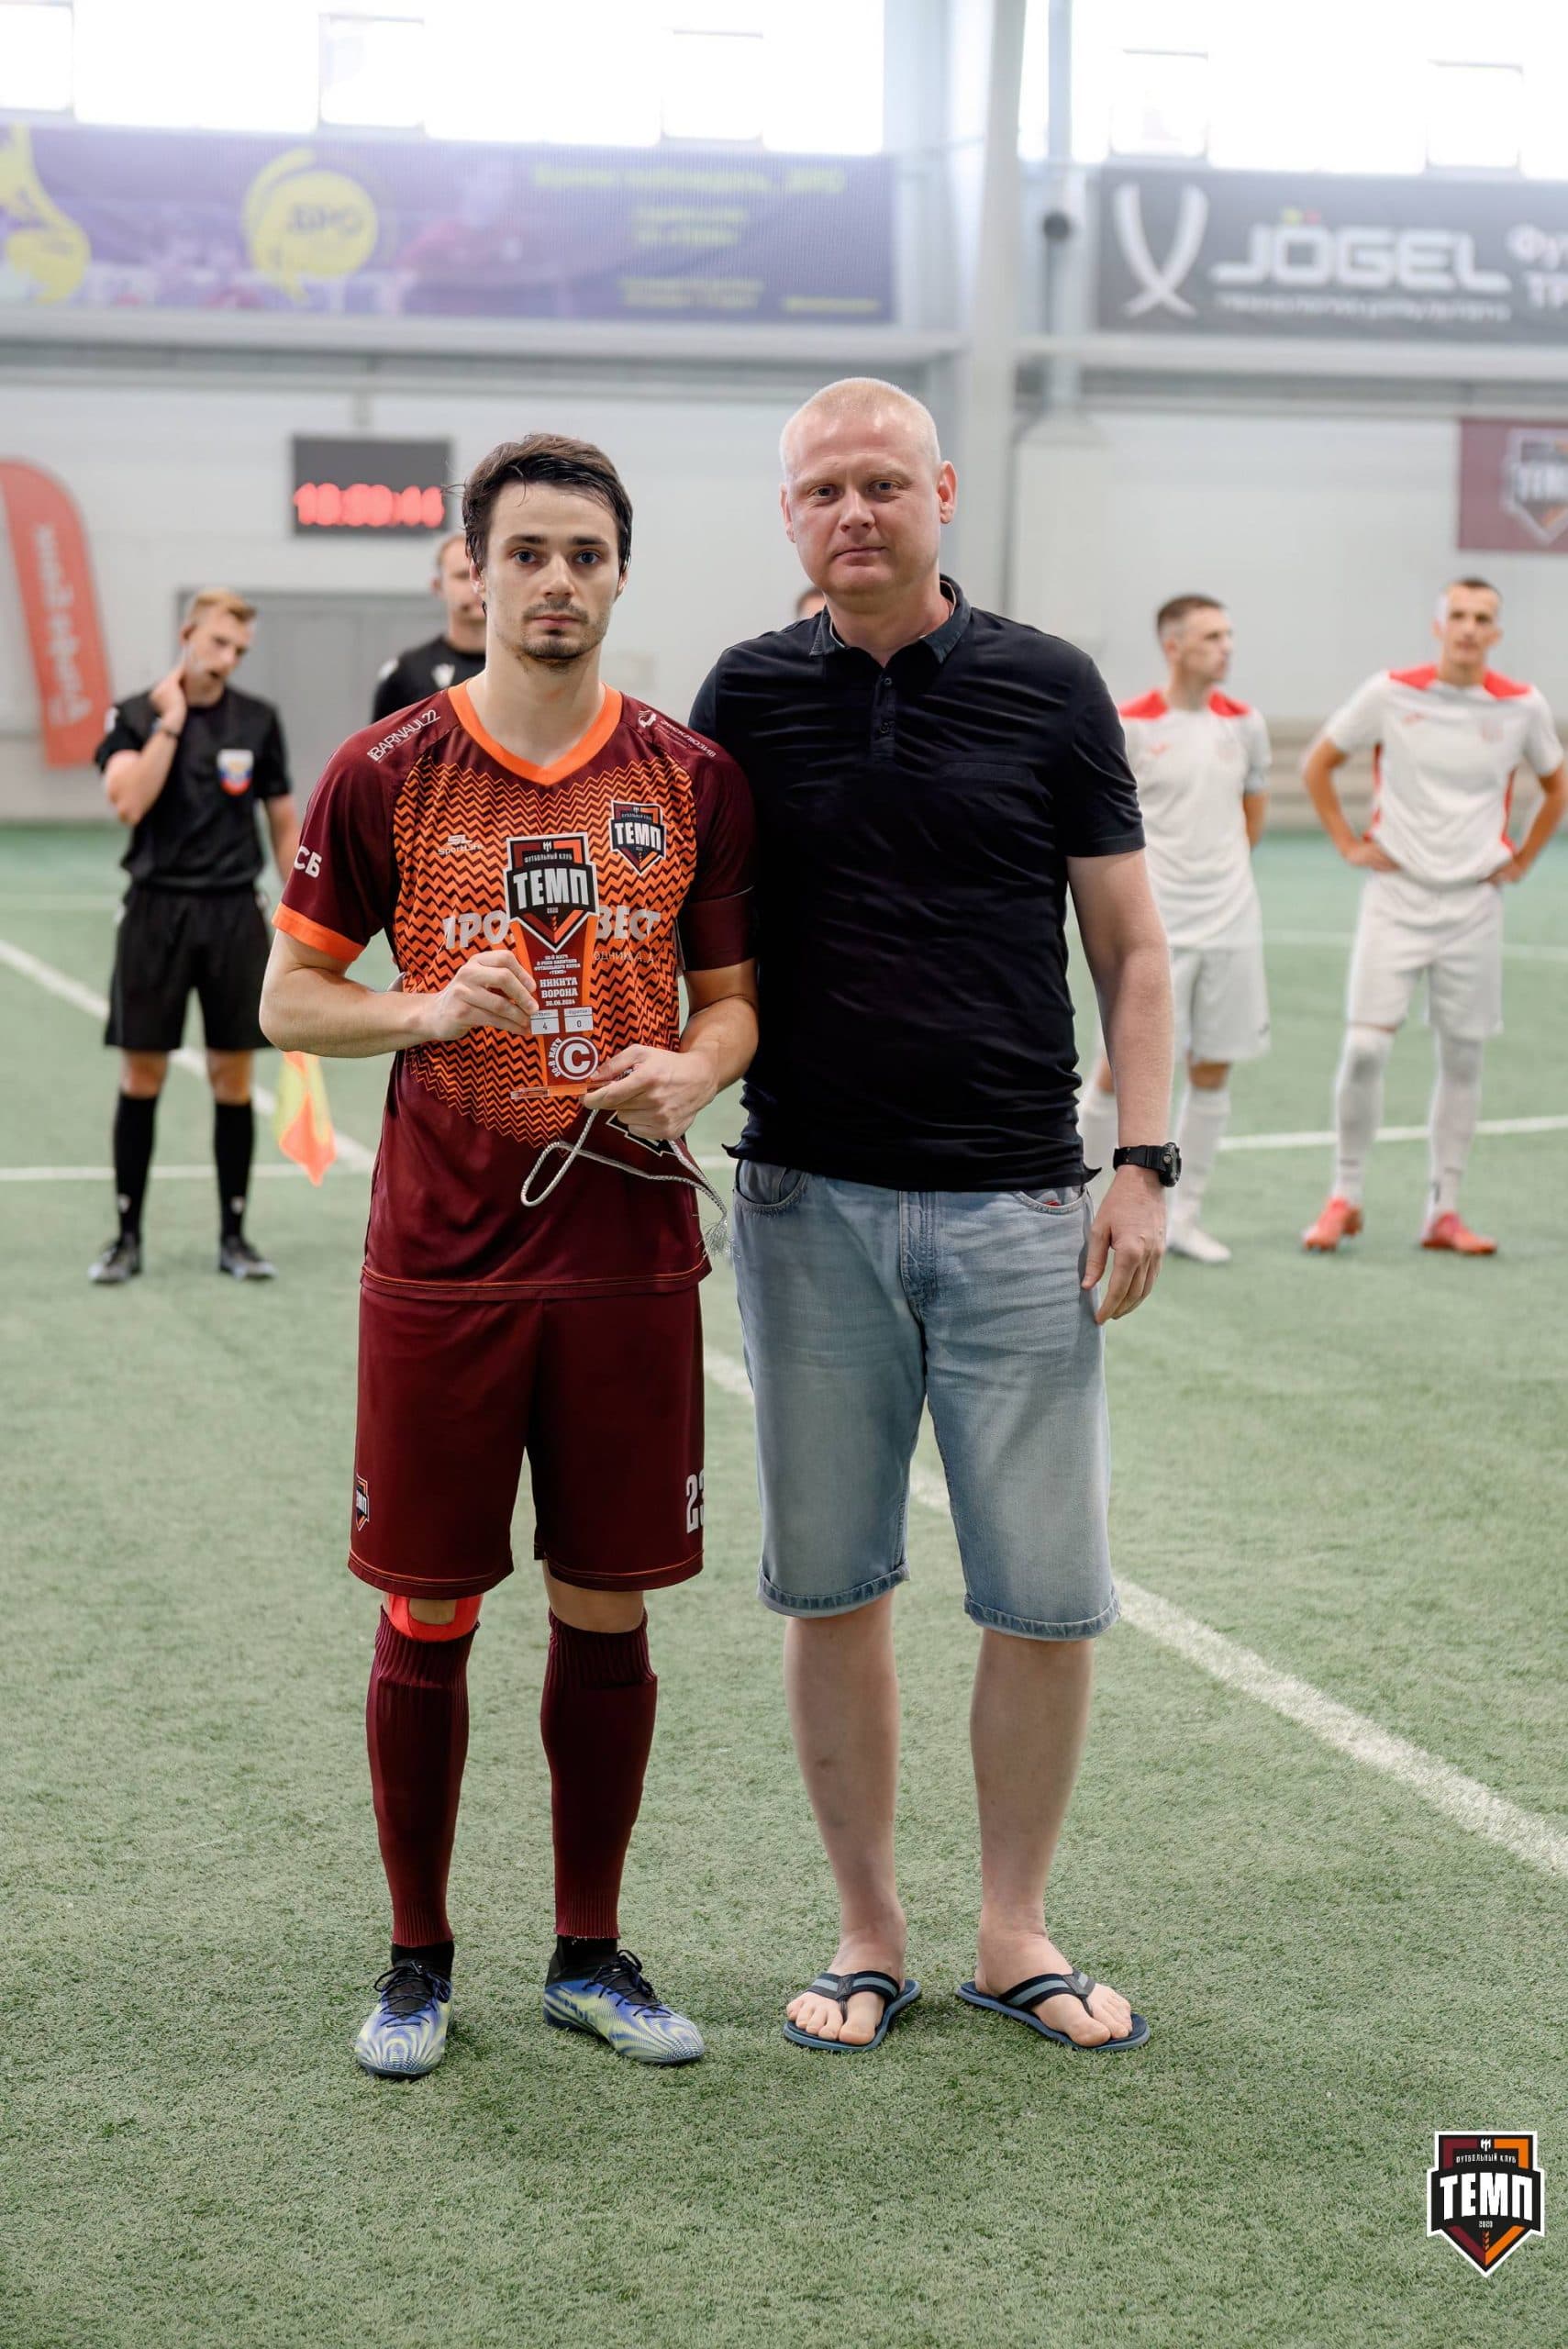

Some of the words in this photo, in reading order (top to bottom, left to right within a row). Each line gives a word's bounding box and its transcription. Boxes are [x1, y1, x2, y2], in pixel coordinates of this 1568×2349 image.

[614, 822, 662, 851] ТЕМП
[513, 868, 589, 910] ТЕМП
[539, 976, 578, 988] НИКИТА
[541, 987, 579, 999] ВОРОНА
[542, 1022, 548, 1030] 4
